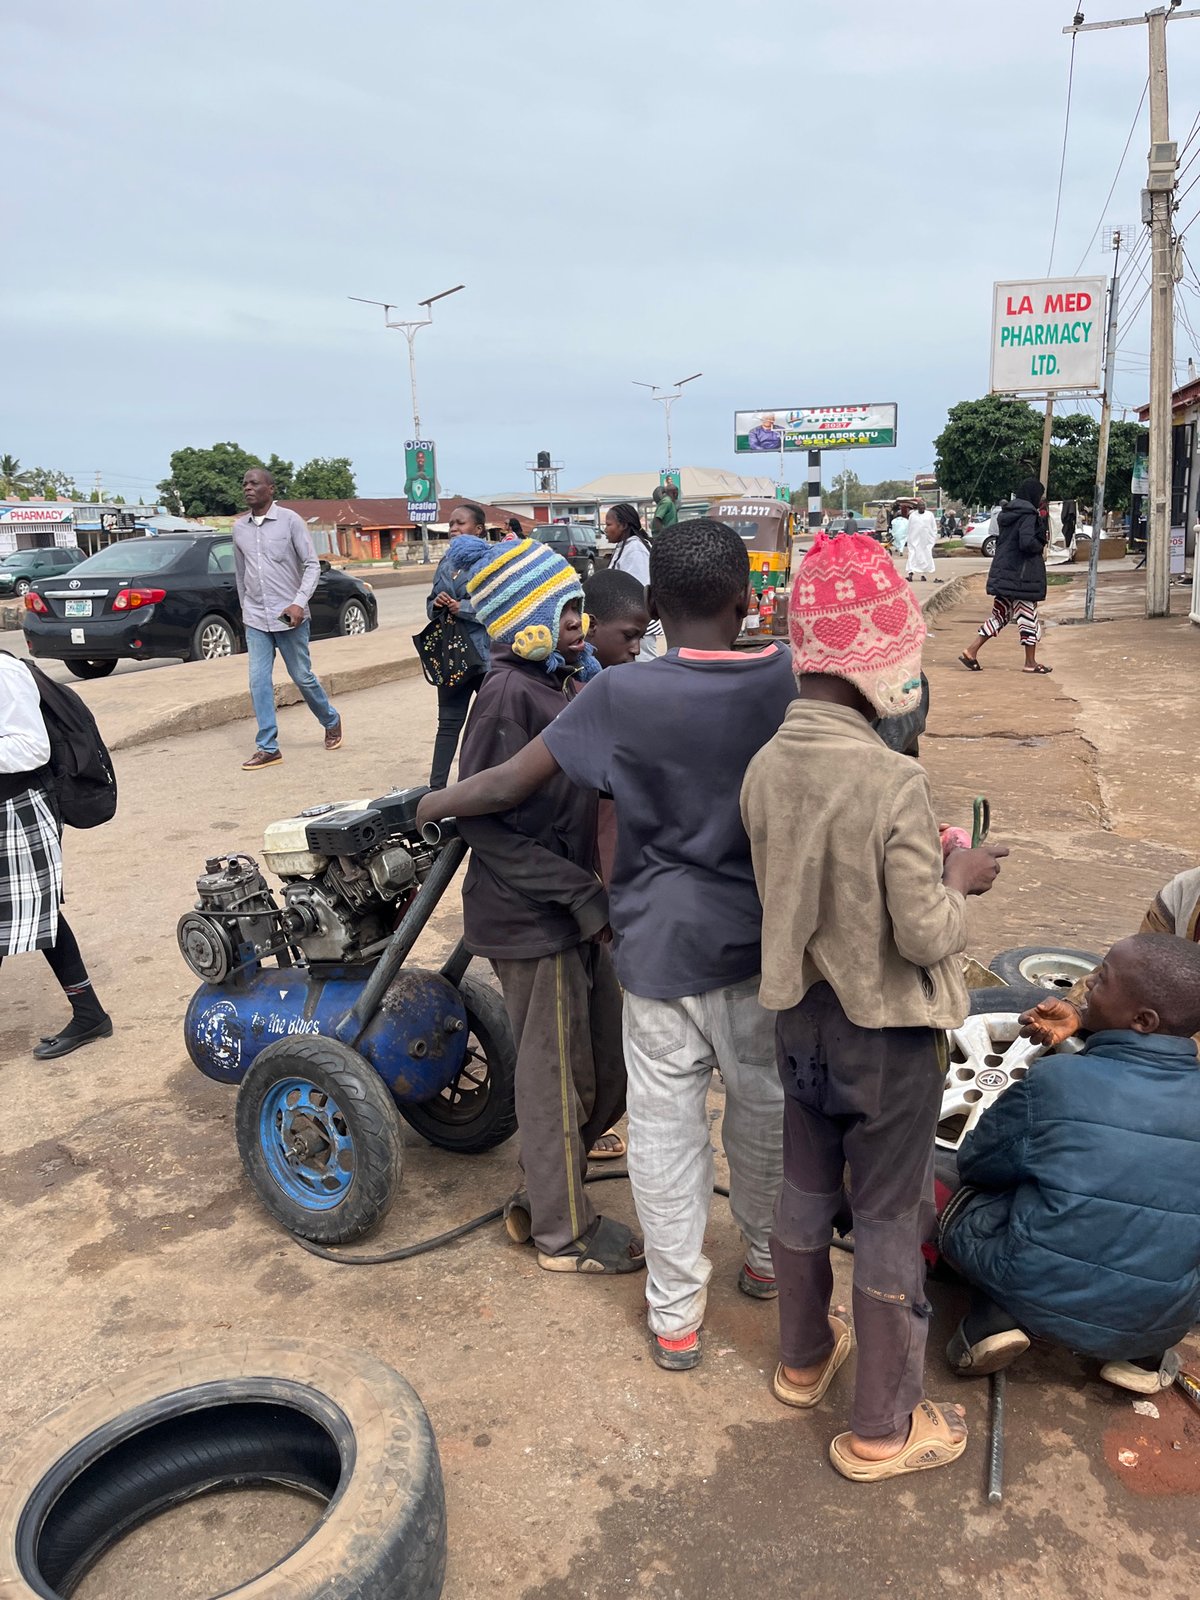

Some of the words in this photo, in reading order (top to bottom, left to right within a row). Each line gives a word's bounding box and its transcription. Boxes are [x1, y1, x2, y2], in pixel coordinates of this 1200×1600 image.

[1006, 295, 1034, 316] LA
[1044, 292, 1092, 314] MED
[1000, 321, 1093, 348] PHARMACY
[1031, 354, 1060, 376] LTD.
[808, 405, 869, 414] TRUST
[807, 416, 869, 424] UNITY
[785, 433, 827, 441] DANLADI
[408, 501, 437, 511] Location
[10, 510, 64, 520] PHARMACY
[410, 511, 436, 522] Guard
